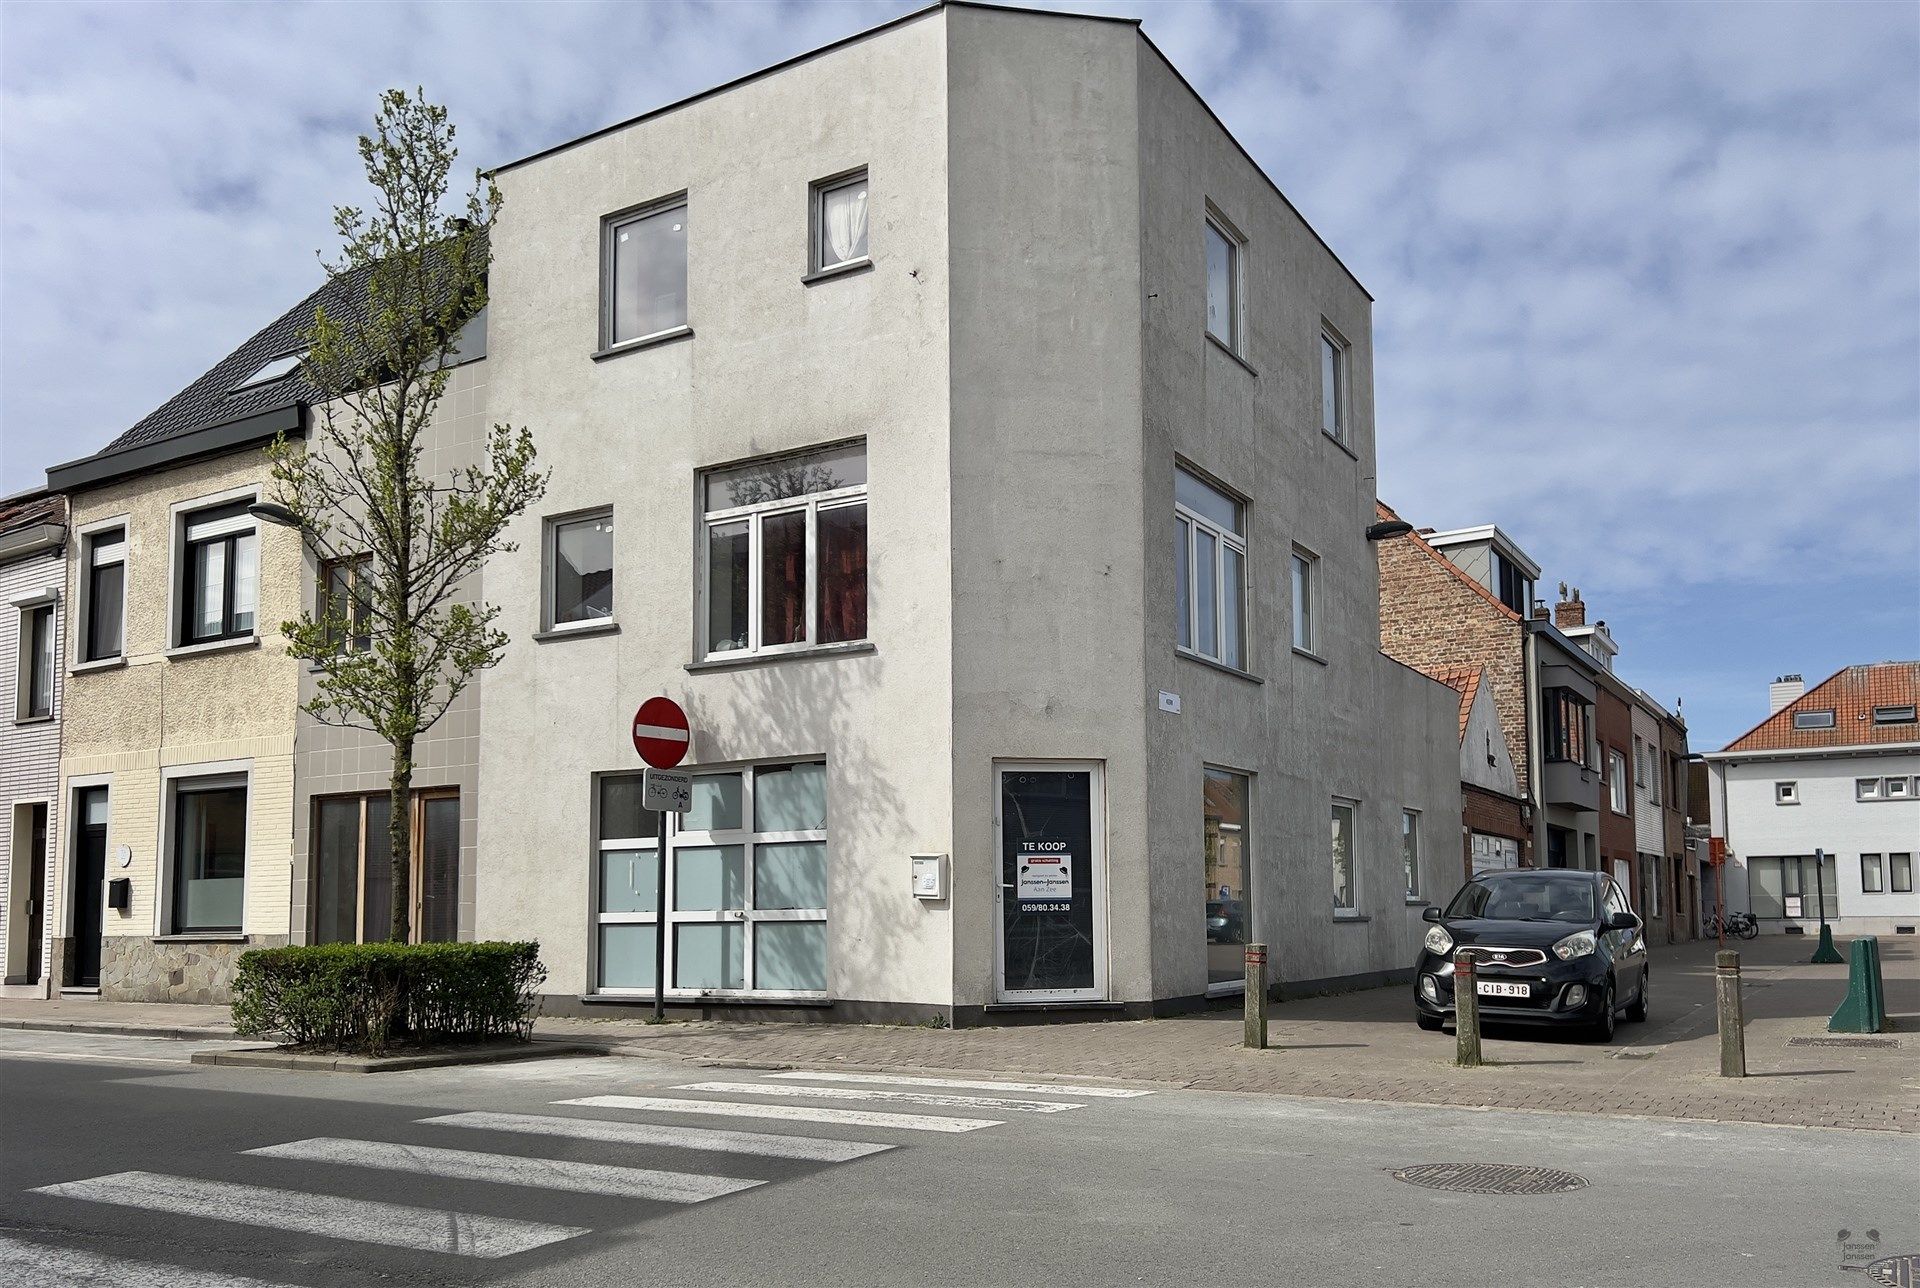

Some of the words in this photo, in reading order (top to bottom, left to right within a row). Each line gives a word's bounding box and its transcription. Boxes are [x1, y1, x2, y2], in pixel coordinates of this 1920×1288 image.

[650, 774, 688, 783] UITGEZONDERD
[1022, 842, 1035, 851] TE
[1038, 842, 1066, 851] KOOP
